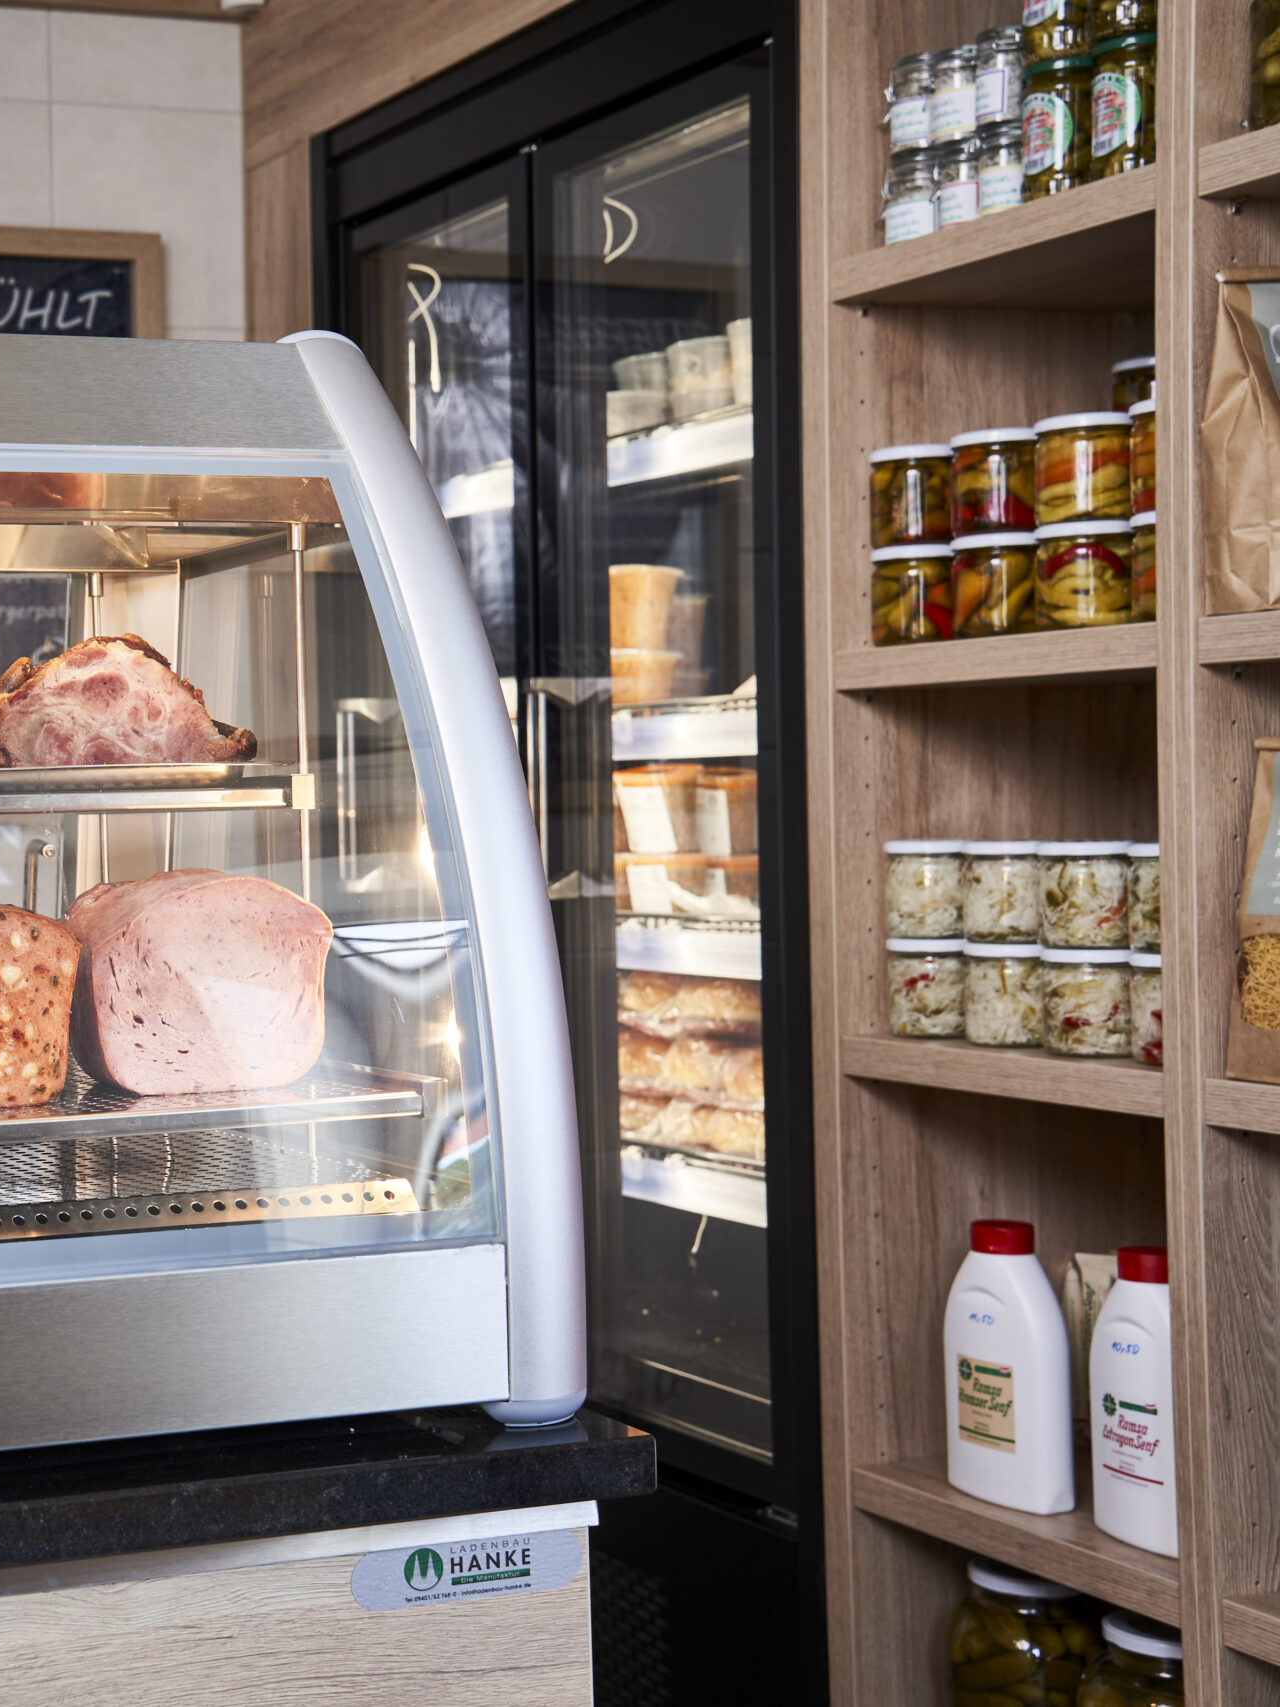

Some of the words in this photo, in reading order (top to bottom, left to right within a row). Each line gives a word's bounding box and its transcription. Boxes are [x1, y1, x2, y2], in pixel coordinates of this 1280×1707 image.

[1134, 1434, 1160, 1457] Senf
[450, 1538, 530, 1554] LADENBAU
[450, 1548, 531, 1574] HANKE
